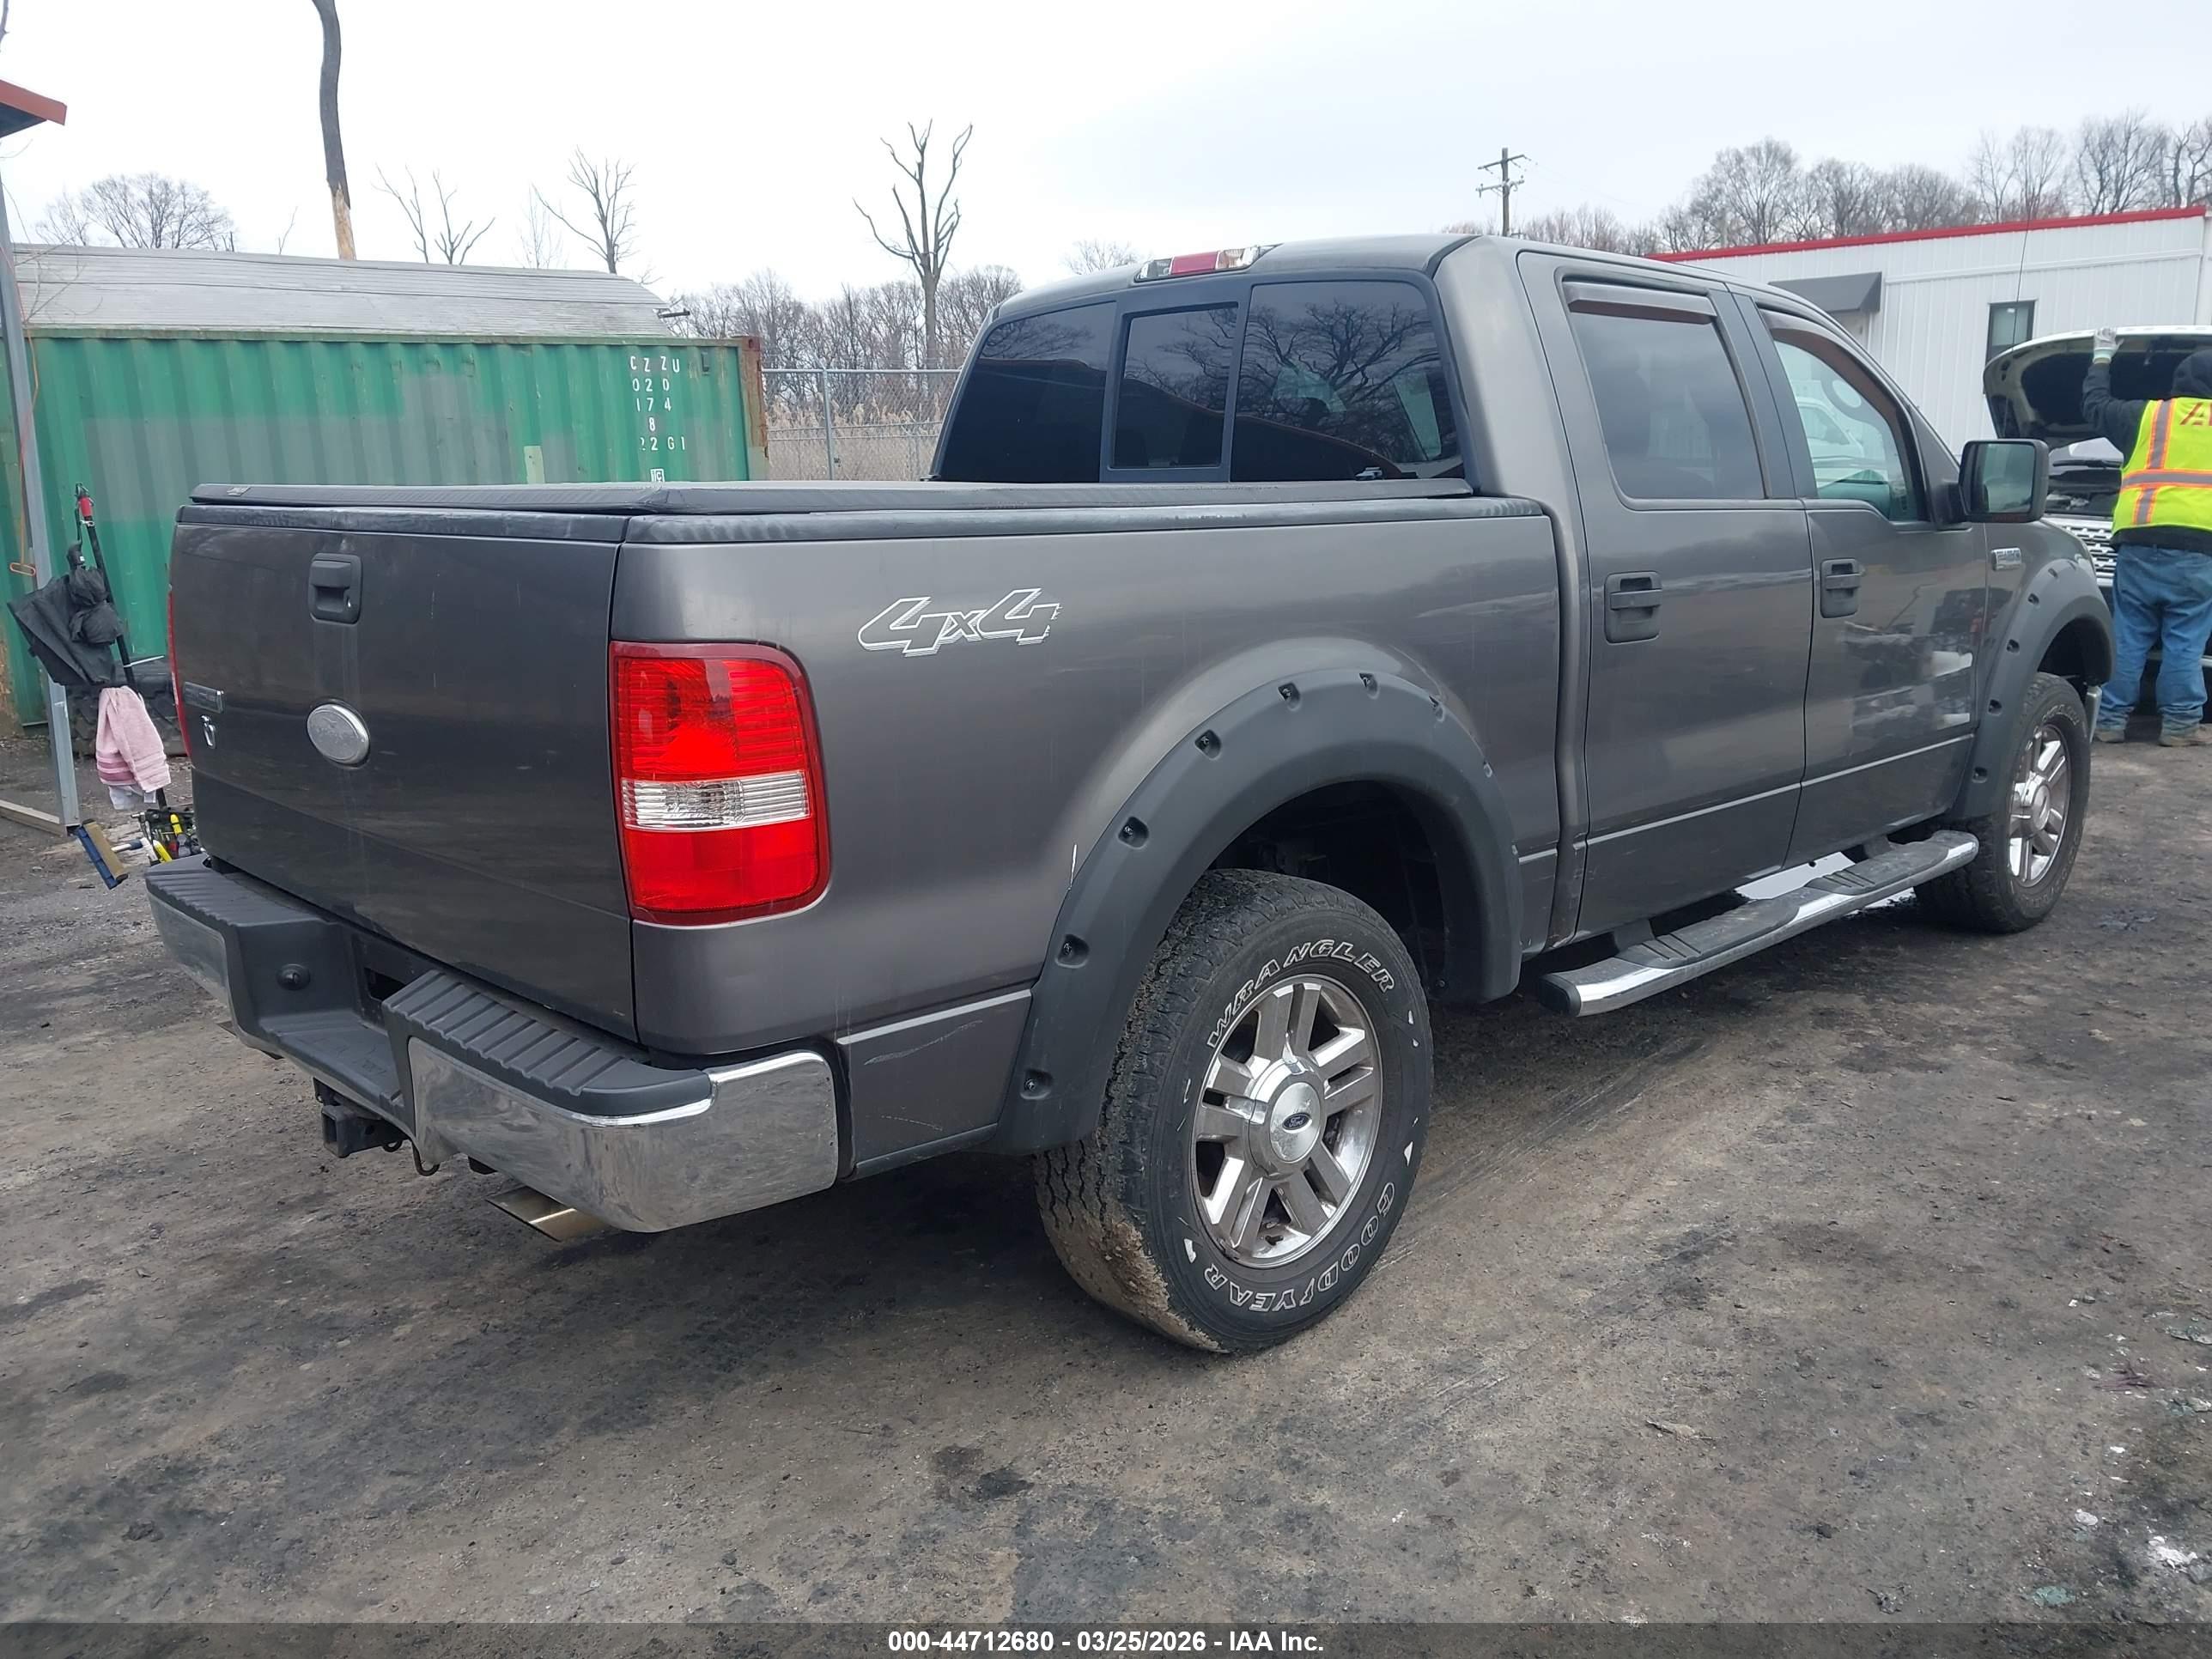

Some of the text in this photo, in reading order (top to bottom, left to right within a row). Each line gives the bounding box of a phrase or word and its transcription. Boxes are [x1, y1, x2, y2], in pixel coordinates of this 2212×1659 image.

[648, 416, 656, 432] 8
[858, 588, 1062, 657] 4x4
[1206, 939, 1395, 1048] WRANGLER
[1204, 1182, 1395, 1311] GOODYEAR
